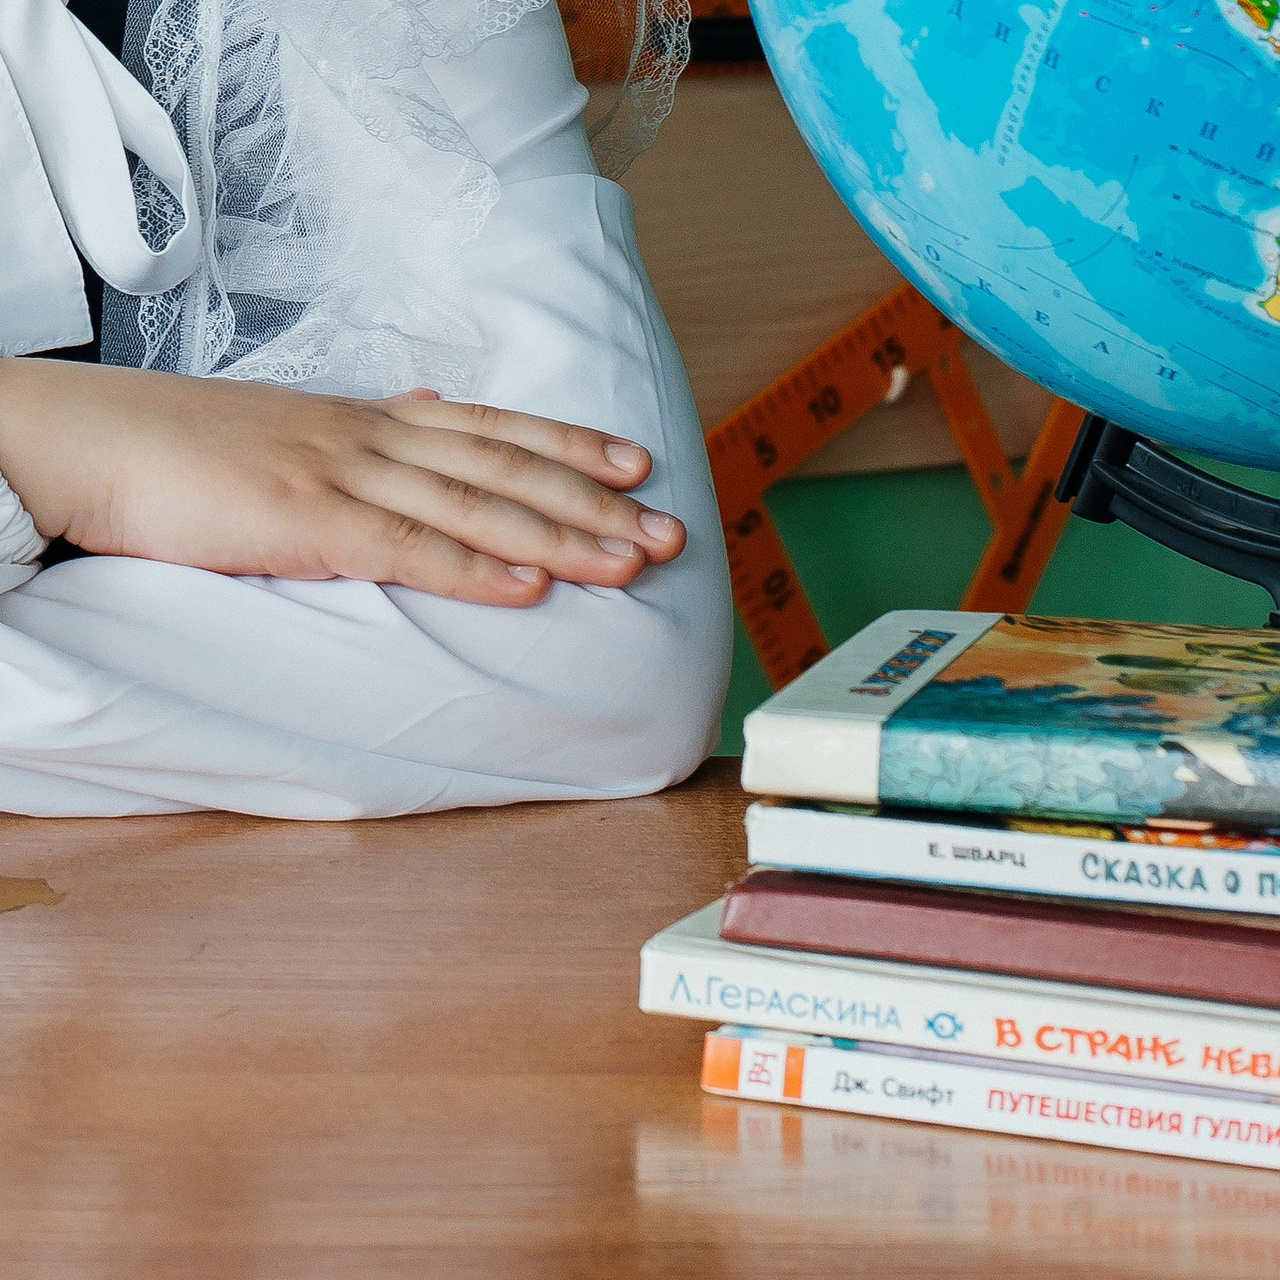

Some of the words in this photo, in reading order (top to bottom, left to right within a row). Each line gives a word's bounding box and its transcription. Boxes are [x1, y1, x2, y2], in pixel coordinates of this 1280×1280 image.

[951, 844, 1028, 869] ШВАРЦ
[1081, 851, 1207, 892] СКАЗКА
[1258, 872, 1280, 898] П
[995, 1017, 1022, 1048] В
[1033, 1023, 1187, 1068] СТРАНЕ
[1201, 1044, 1280, 1080] НЕВ
[880, 1076, 955, 1108] Свифт
[986, 1088, 1183, 1136] ПУТЕШЕСТВИЯ
